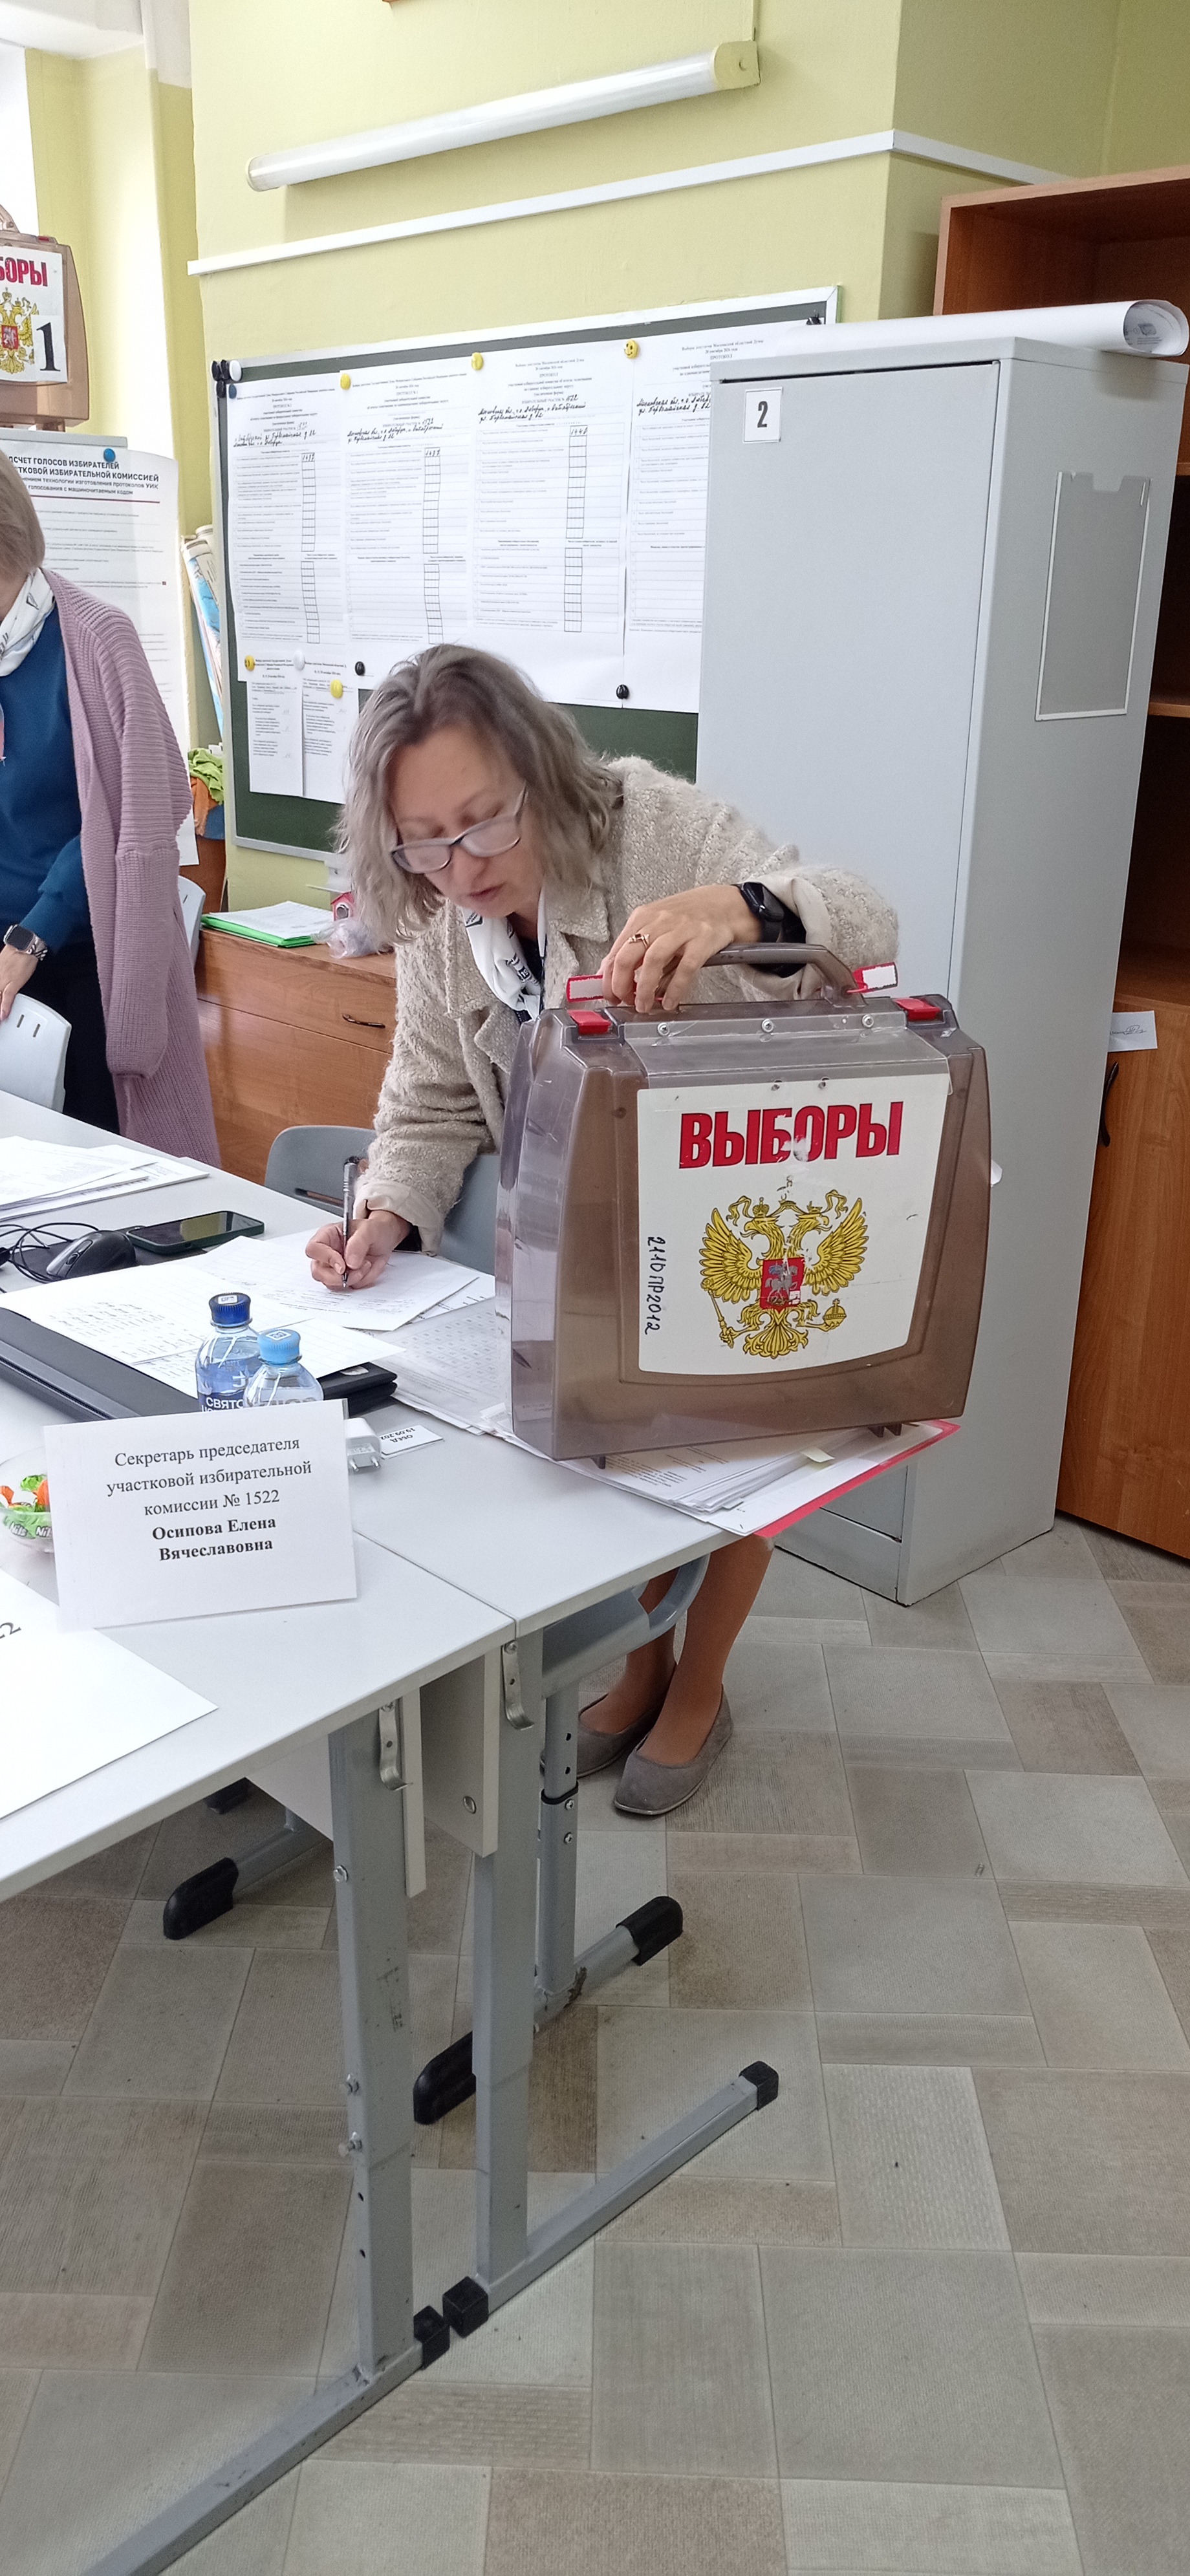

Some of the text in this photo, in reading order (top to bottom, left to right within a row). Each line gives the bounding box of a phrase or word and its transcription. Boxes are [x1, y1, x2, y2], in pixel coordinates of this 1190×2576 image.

[36, 322, 61, 372] 1
[757, 401, 768, 428] 2
[15, 466, 159, 482] ТКОВОЙ ИЗБИРАТЕЛЬНОЙ КОМИССИЕЙ
[33, 457, 67, 467] ГОЛОСОВ
[69, 460, 120, 470] ИЗБИРАТЕЛЕЙ
[678, 1100, 904, 1170] ВЫБОРЫ
[380, 1428, 416, 1440] 19.09.202
[114, 1438, 301, 1468] Секретарь председателя
[106, 1460, 313, 1496] участковой избирательной
[144, 1490, 281, 1516] комиссии № 1522
[36, 1525, 52, 1538] Nil
[152, 1517, 276, 1541] Осипова Елена
[159, 1541, 274, 1562] Вячеславовна
